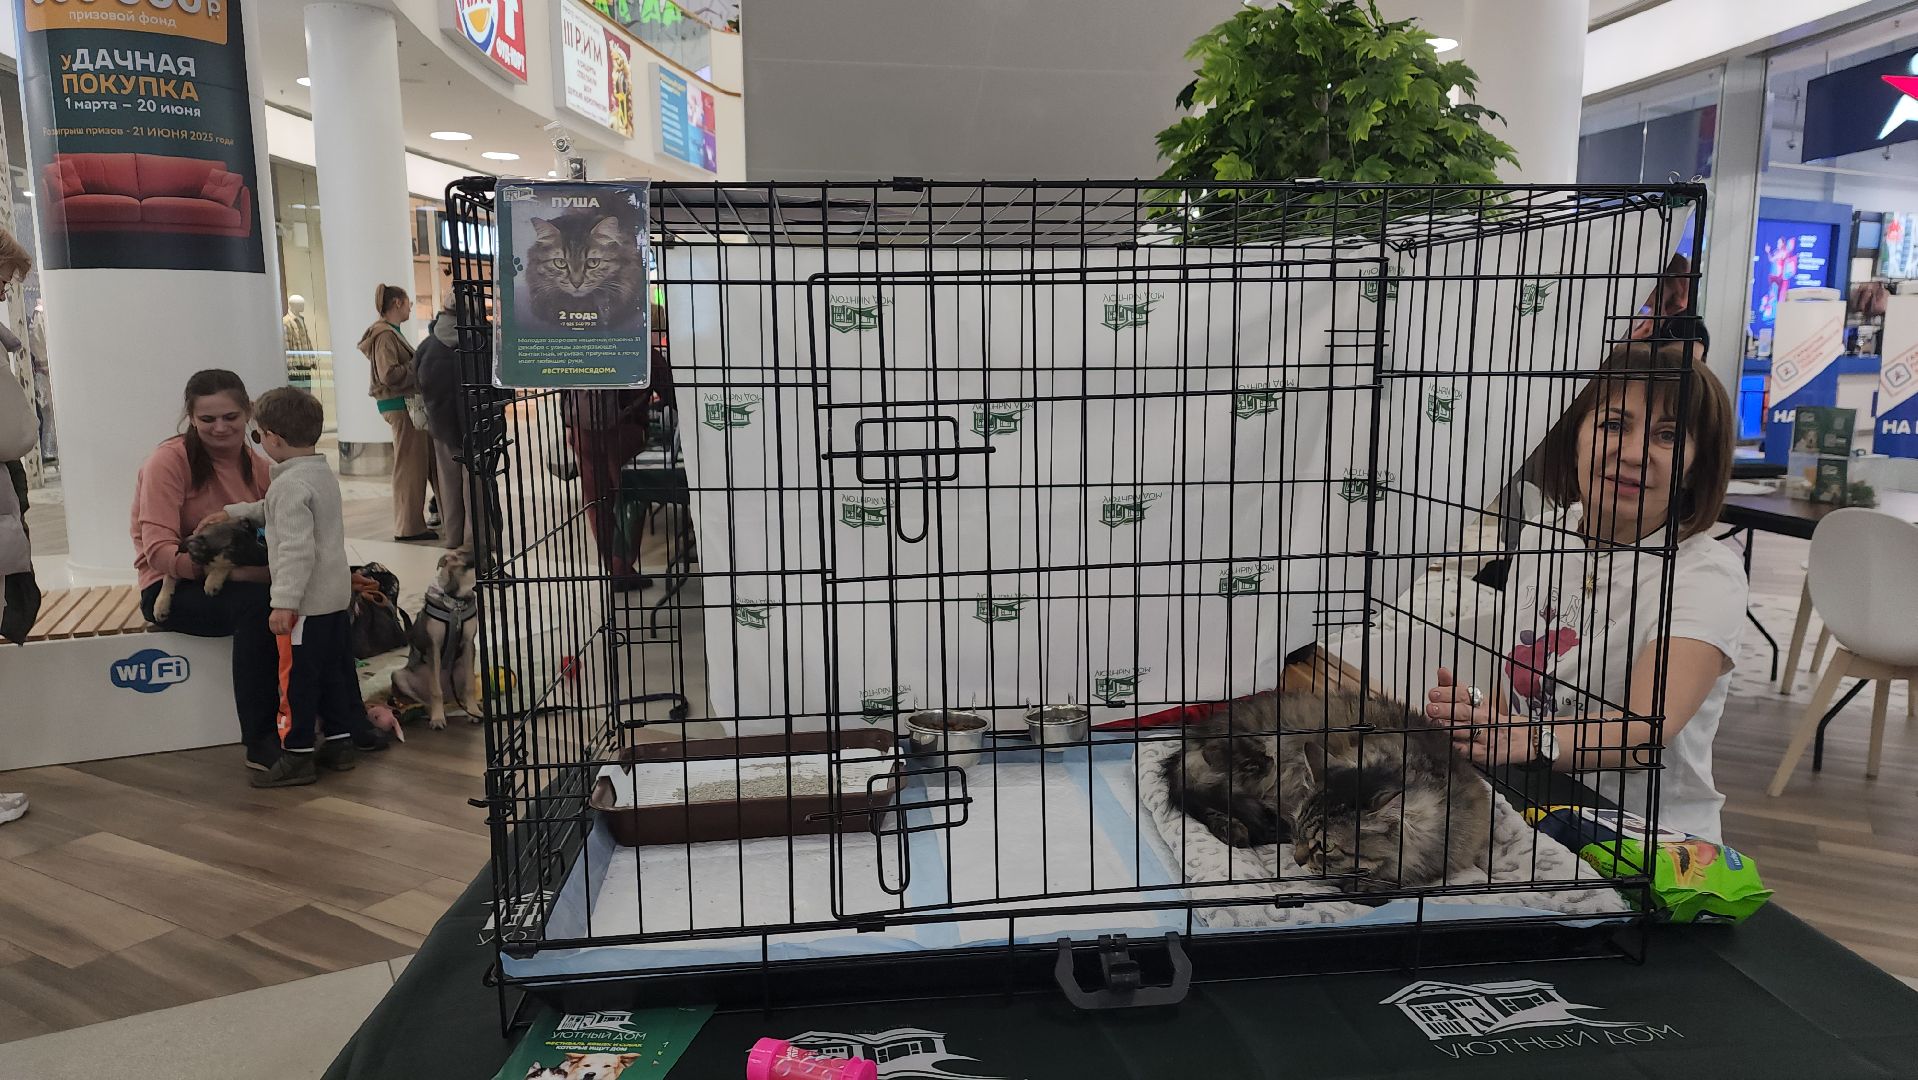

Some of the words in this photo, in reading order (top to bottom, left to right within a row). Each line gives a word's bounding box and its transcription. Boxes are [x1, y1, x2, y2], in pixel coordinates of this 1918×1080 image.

[69, 11, 135, 23] призовой
[138, 12, 177, 28] фонд
[61, 48, 197, 77] уДАЧНАЯ
[62, 73, 199, 101] ПОКУПКА
[65, 97, 71, 110] 1
[74, 100, 118, 113] марта
[137, 99, 157, 112] 20
[160, 104, 201, 118] июня
[86, 127, 124, 136] призов
[133, 127, 144, 136] 21
[147, 128, 188, 140] ИЮНЯ
[190, 131, 214, 142] 2025
[215, 136, 234, 146] года
[551, 197, 600, 208] ПУША
[558, 310, 568, 320] 2
[569, 312, 598, 321] года
[1882, 419, 1911, 434] НА
[551, 1031, 612, 1039] УЮТНЫЙ
[613, 1032, 647, 1041] ДОМ
[1433, 1029, 1599, 1059] УЮТНЫЙ
[1603, 1024, 1685, 1045] ДОМ
